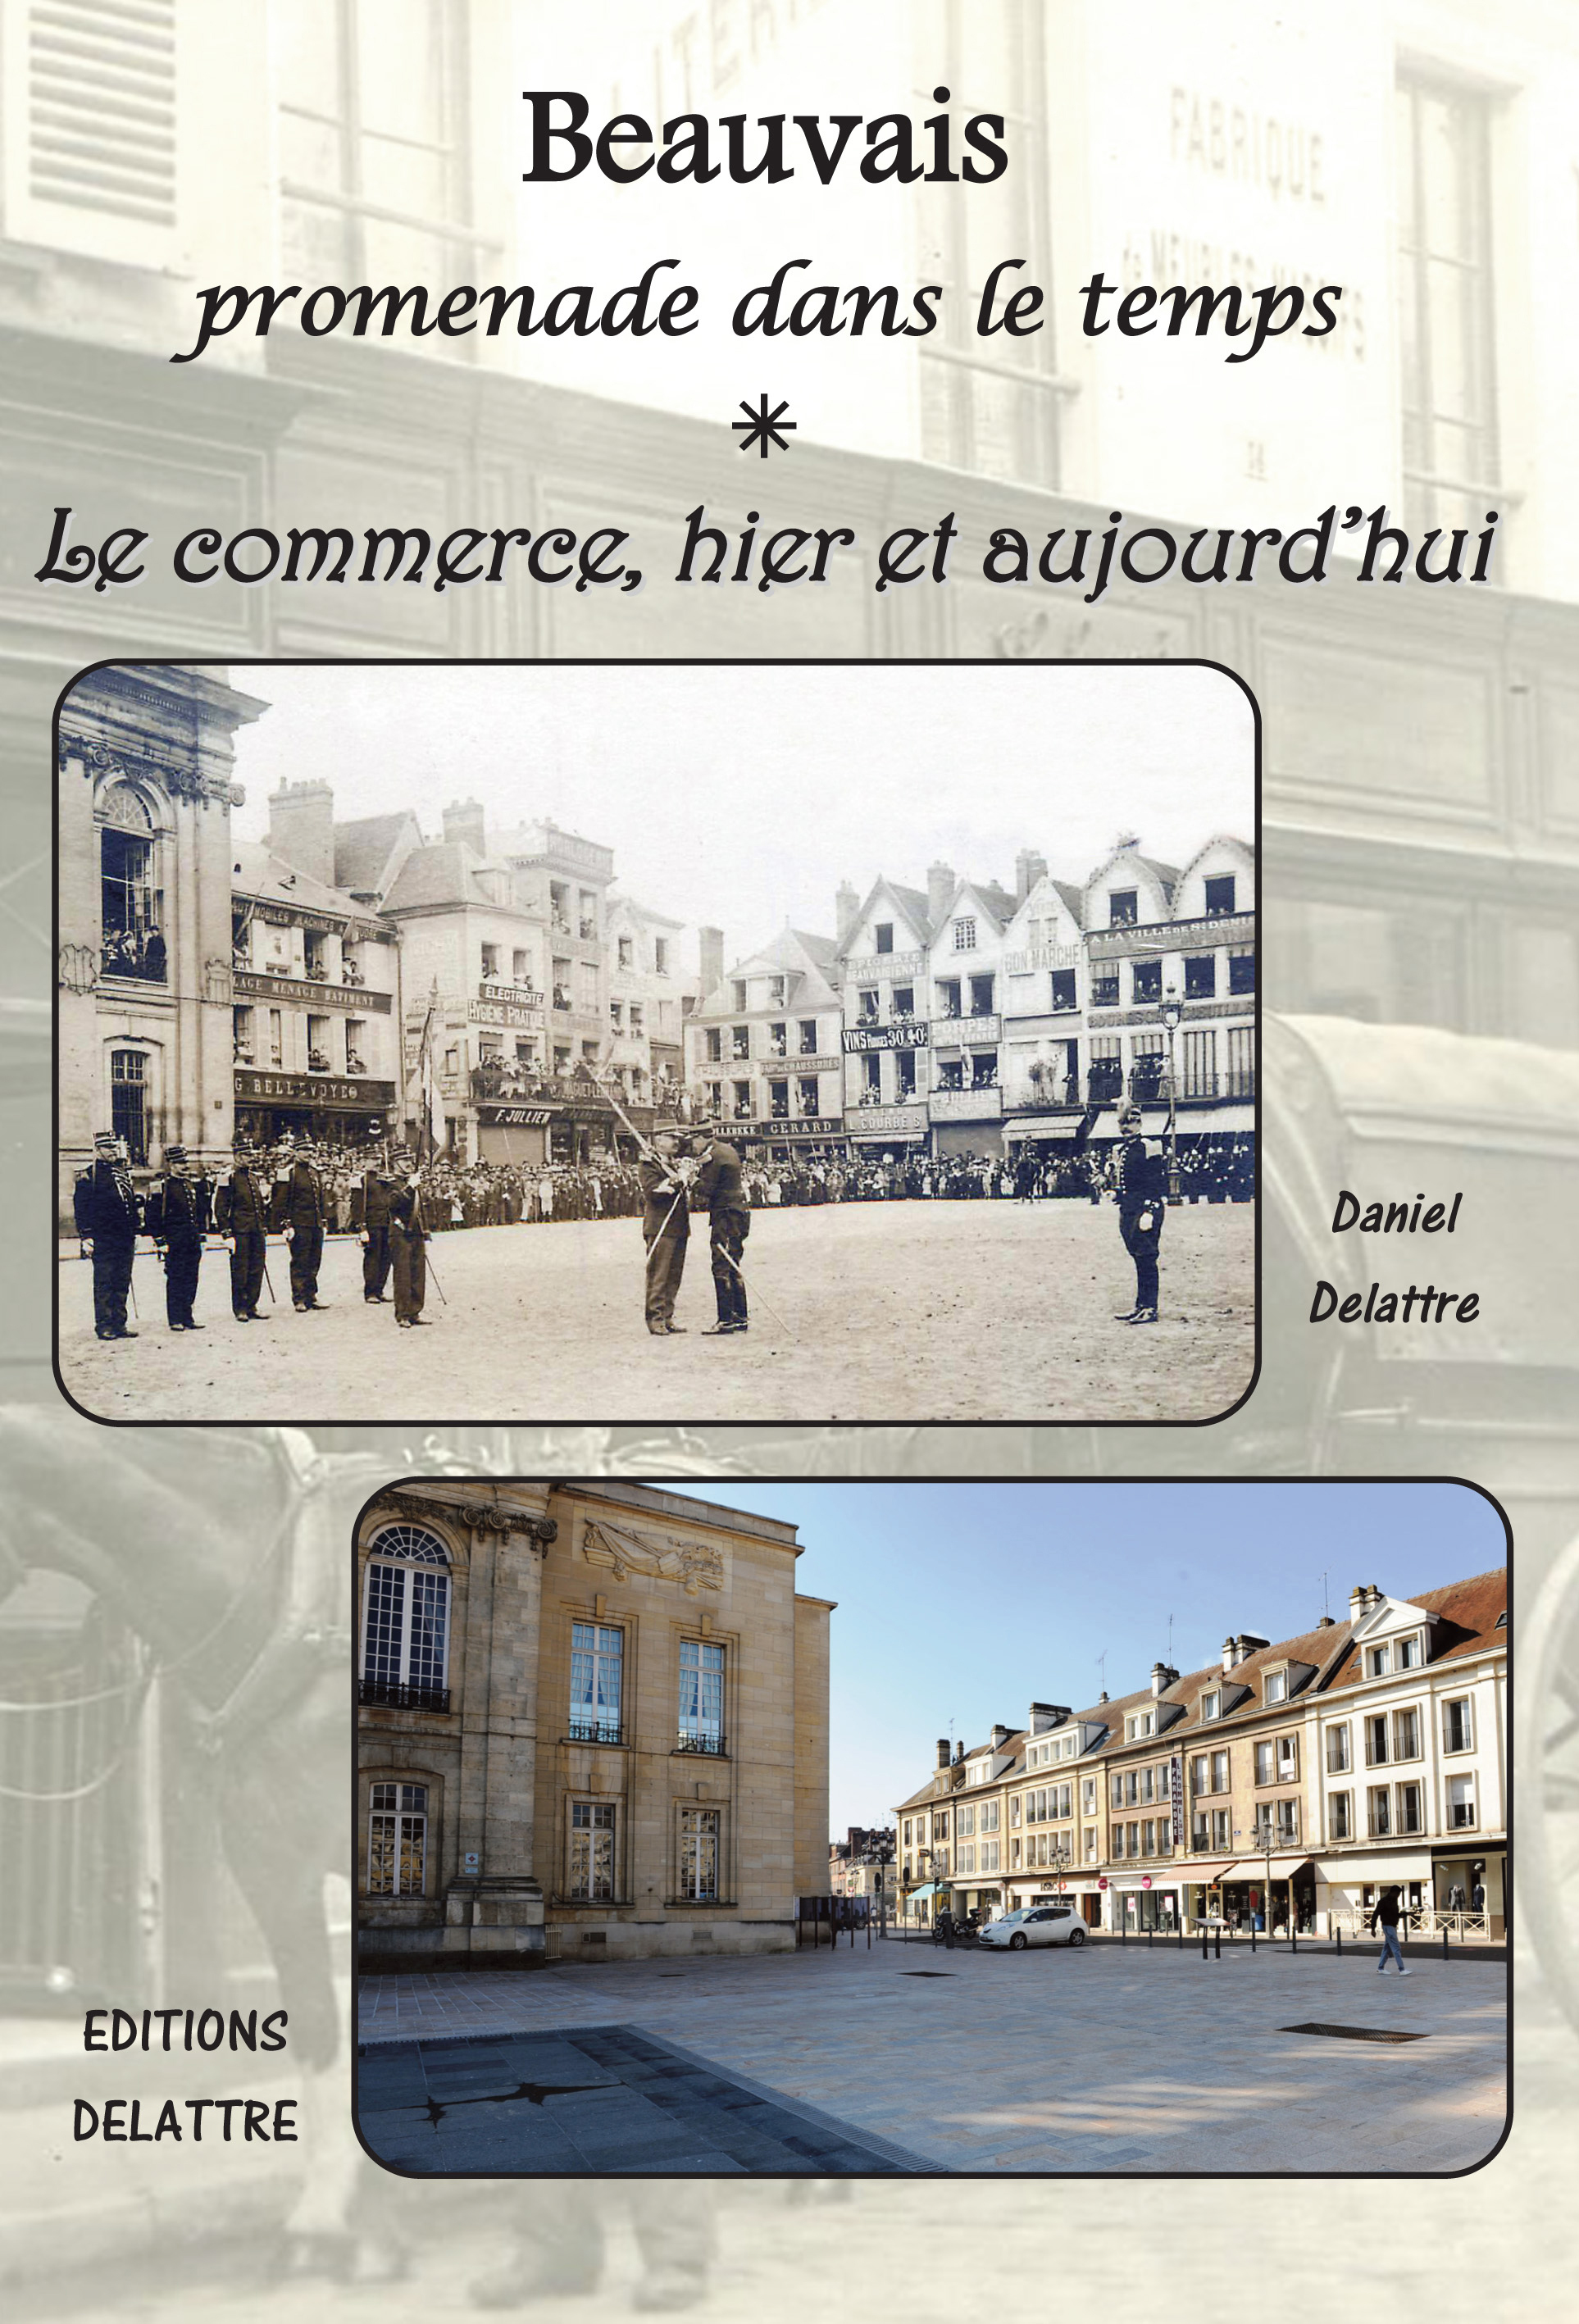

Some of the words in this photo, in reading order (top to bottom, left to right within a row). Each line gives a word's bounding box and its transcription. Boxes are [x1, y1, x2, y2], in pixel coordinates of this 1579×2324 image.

[1171, 87, 1325, 203] FABRIQUE
[1104, 932, 1124, 943] LA
[1127, 926, 1172, 939] VILLE
[1004, 950, 1028, 972] BON
[843, 1030, 867, 1052] VINS
[234, 1076, 242, 1092] G
[253, 1078, 348, 1099] BELLEVOYE
